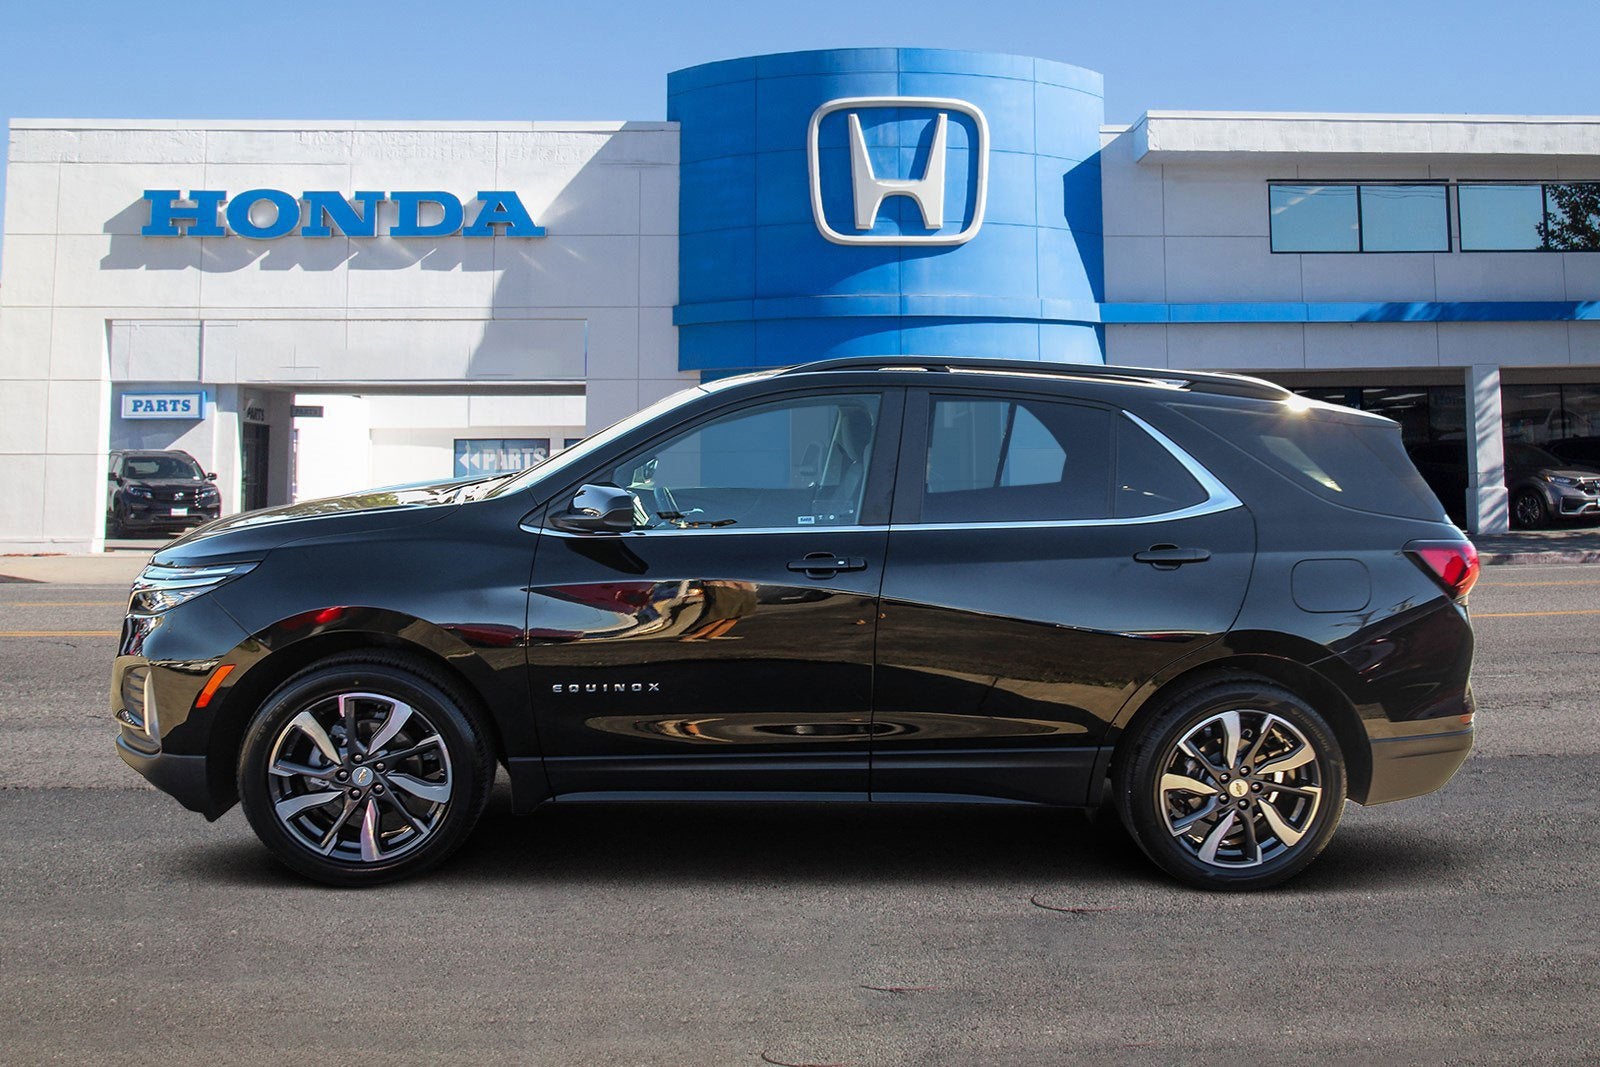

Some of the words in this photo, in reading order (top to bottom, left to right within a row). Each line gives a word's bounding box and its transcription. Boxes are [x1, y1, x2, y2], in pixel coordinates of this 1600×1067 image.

[141, 189, 547, 239] HONDA
[132, 399, 191, 412] PARTS
[482, 447, 547, 471] PARTS
[552, 682, 660, 693] EQUINOX
